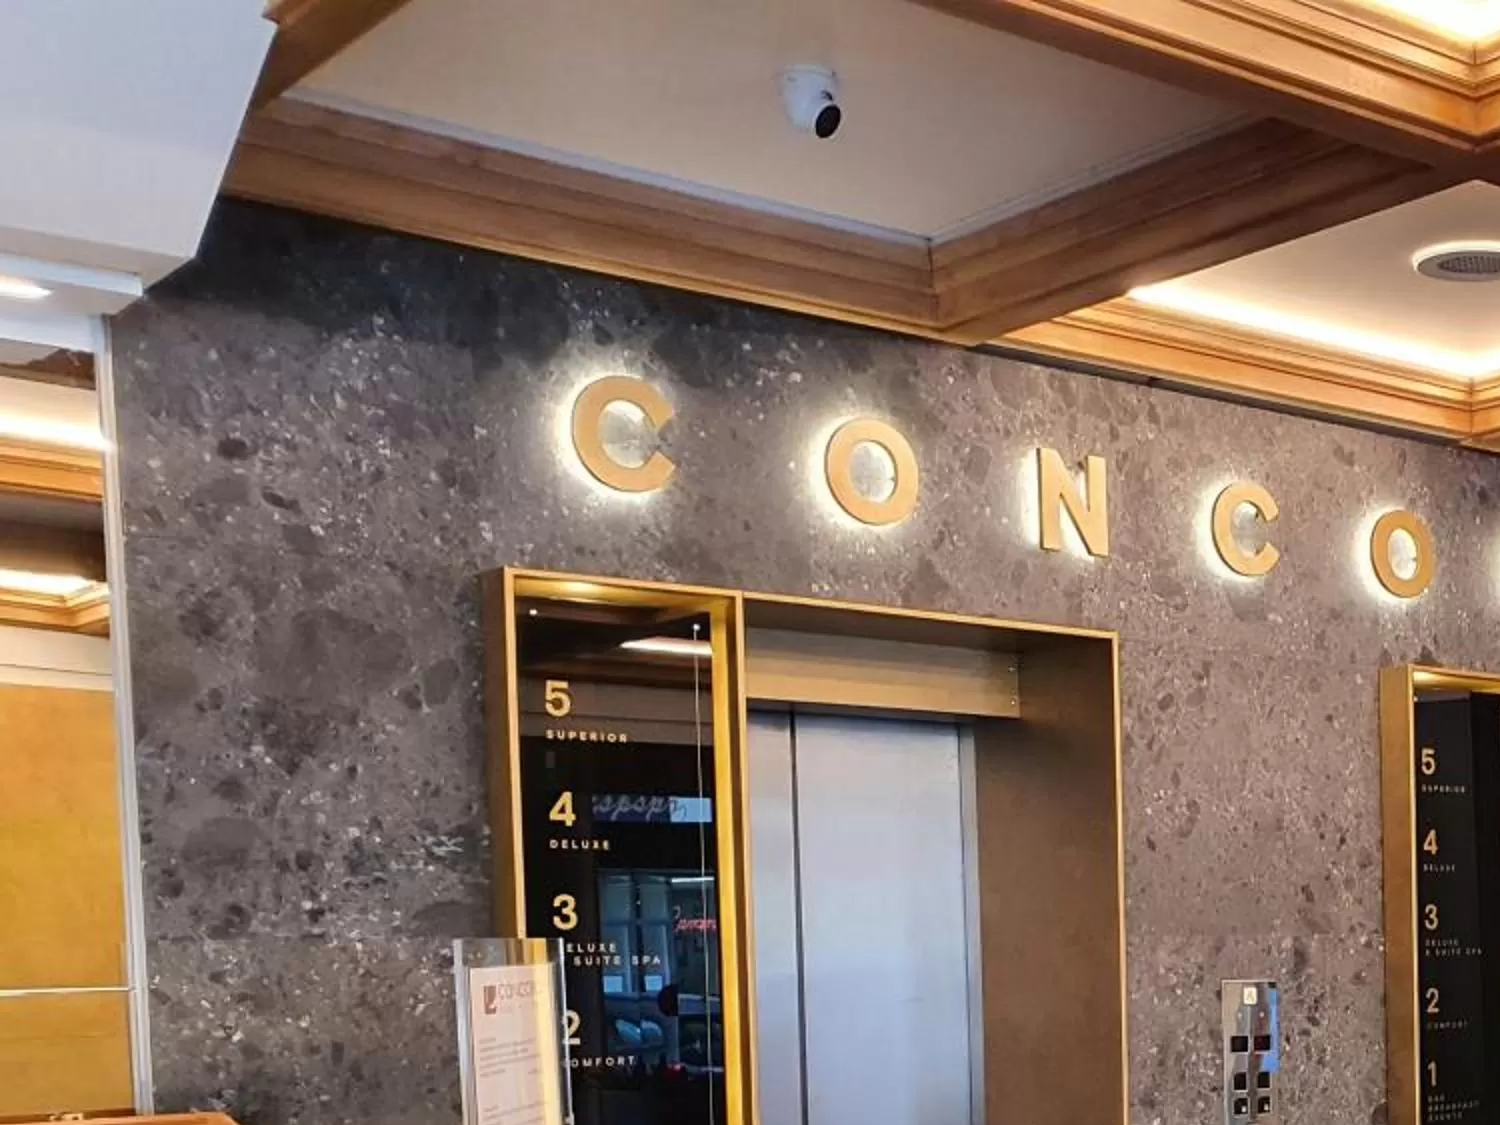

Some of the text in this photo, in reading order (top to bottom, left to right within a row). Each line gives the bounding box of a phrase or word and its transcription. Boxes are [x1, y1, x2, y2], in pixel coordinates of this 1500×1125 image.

[544, 679, 572, 718] 5
[545, 729, 628, 744] SUPERIOR
[1420, 748, 1437, 776] 5
[548, 790, 577, 828] 4
[549, 839, 610, 851] DELUXE
[1423, 828, 1439, 856] 4
[552, 893, 579, 931] 3
[1424, 903, 1440, 930] 3
[565, 942, 617, 953] ELUXE
[573, 955, 662, 966] SUITE SPA
[1425, 987, 1441, 1014] 2
[561, 1010, 582, 1046] 2
[563, 1055, 635, 1068] OMFORT
[1426, 1060, 1439, 1088] 1
